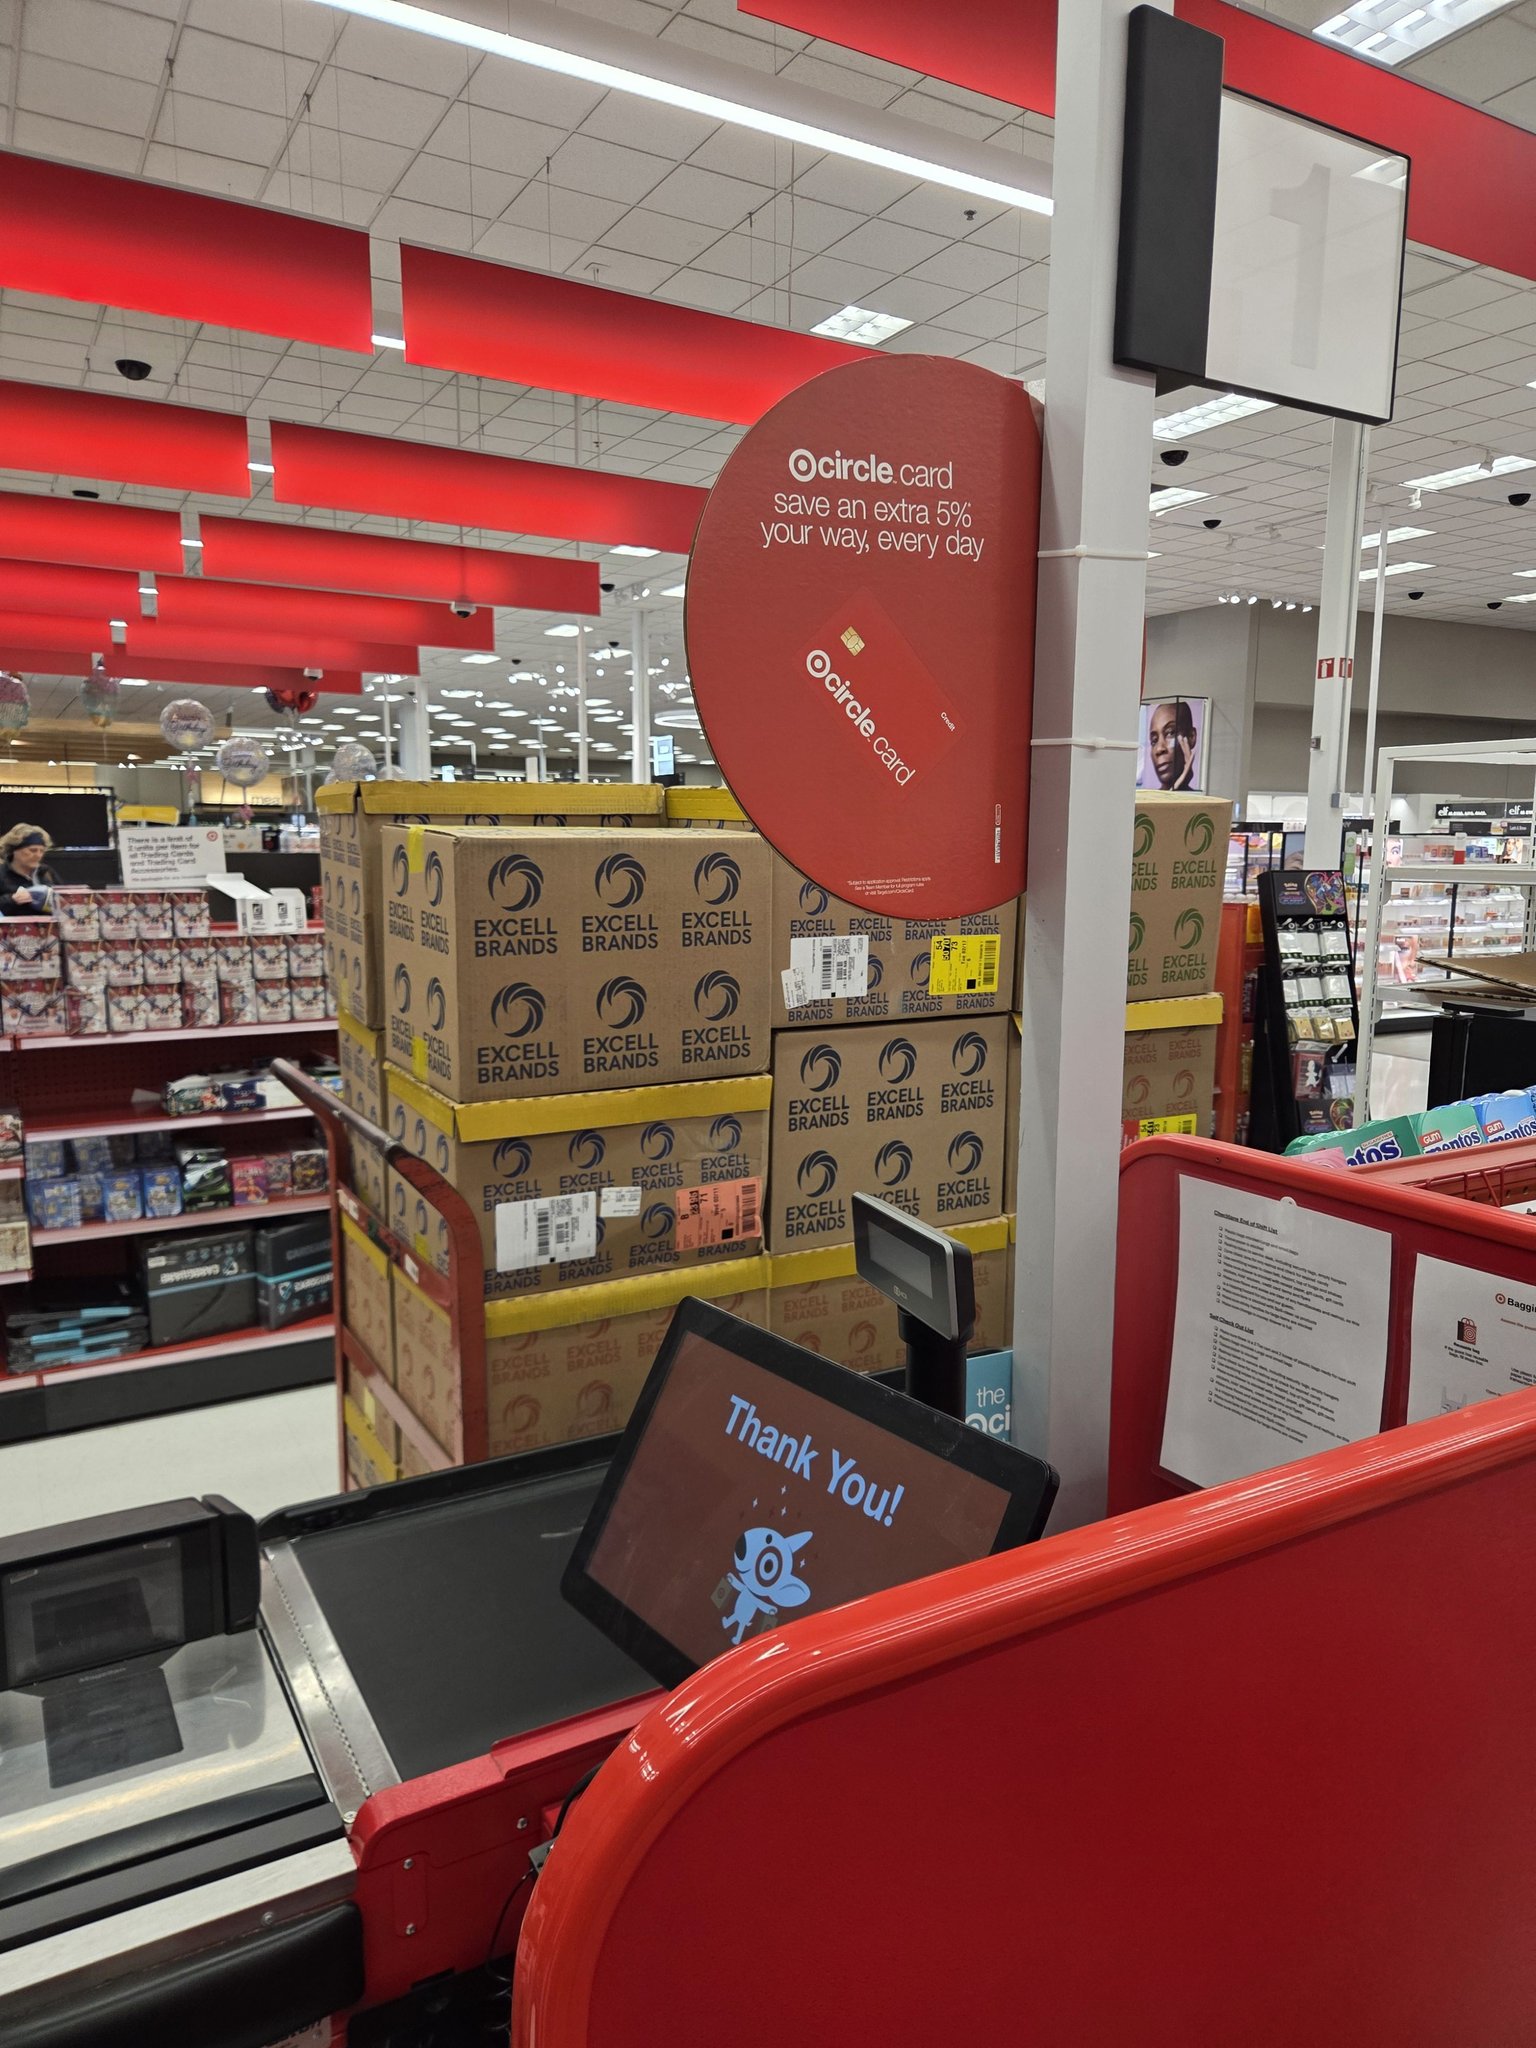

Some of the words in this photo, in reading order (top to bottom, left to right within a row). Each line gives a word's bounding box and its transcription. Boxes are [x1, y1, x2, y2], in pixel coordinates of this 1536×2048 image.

[818, 450, 893, 484] circle
[900, 461, 952, 490] card
[774, 493, 830, 517] save
[837, 498, 866, 520] an
[874, 498, 930, 524] extra
[760, 522, 813, 548] your
[820, 526, 870, 554] way,
[878, 530, 939, 559] every
[946, 530, 985, 562] day
[824, 672, 876, 738] circle
[873, 736, 916, 786] card
[140, 851, 169, 859] Trading
[1132, 862, 1158, 876] CELL
[1172, 860, 1217, 875] EXCELL
[1132, 876, 1157, 891] NDS
[1170, 874, 1216, 890] BRANDS
[389, 901, 414, 924] EXCELL
[682, 911, 752, 929] EXCELL
[961, 915, 999, 926] EXCELL
[389, 920, 415, 942] BRANDS
[421, 910, 449, 936] EXCELL
[474, 917, 558, 937] EXCELL
[582, 914, 658, 933] EXCELL
[790, 919, 836, 932] EXCELL
[849, 918, 892, 930] EXCELL
[421, 931, 450, 956] BRANDS
[475, 937, 558, 957] BRANDS
[582, 931, 658, 952] BRANDS
[682, 929, 752, 947] BRANDS
[1128, 958, 1149, 973] ELL
[1163, 954, 1207, 969] EXCELL
[1161, 967, 1206, 983] BRANDS
[847, 992, 889, 1005] EXCELL
[902, 1002, 943, 1013] BRANDS
[956, 998, 995, 1010] BRANDS
[788, 1009, 833, 1022] BRANDS
[847, 1005, 889, 1017] BRANDS
[392, 1033, 413, 1057] BRAND
[583, 1033, 659, 1055] EXCELL
[682, 1025, 751, 1046] EXCELL
[477, 1042, 560, 1064] EXCELL
[583, 1052, 659, 1073] BRANDS
[682, 1043, 751, 1064] BRANDS
[427, 1053, 452, 1081] RANDS
[478, 1061, 560, 1084] BRANDS
[867, 1087, 924, 1107] EXCELL
[941, 1079, 994, 1098] EXCELL
[788, 1095, 850, 1116] EXCELL
[867, 1103, 924, 1122] BRANDS
[941, 1095, 994, 1113] BRANDS
[788, 1112, 849, 1132] BRANDS
[1486, 1121, 1504, 1134] GUM
[1423, 1131, 1441, 1145] GUM
[632, 1162, 684, 1180] EXCELL
[701, 1153, 750, 1170] EXCELL
[560, 1171, 615, 1189] EXCELL
[701, 1166, 750, 1183] BRANDS
[483, 1179, 542, 1198] EXCELL
[938, 1177, 990, 1198] EXCELL
[785, 1199, 846, 1222] EXCELL
[937, 1192, 990, 1213] BRANDS
[785, 1215, 846, 1238] BRANDS
[1240, 1218, 1249, 1226] End
[1268, 1226, 1278, 1235] List
[630, 1240, 675, 1257] EXCEL
[698, 1241, 747, 1258] BRANDS
[629, 1251, 680, 1268] BRANDS
[559, 1263, 613, 1282] BRANDS
[484, 1275, 542, 1295] BRANDS
[841, 1286, 879, 1300] EXCEL
[784, 1294, 830, 1310] EXCELL
[841, 1296, 884, 1313] BRANDS
[784, 1307, 830, 1322] BRANDS
[567, 1339, 621, 1359] EXCELL
[492, 1352, 550, 1372] EXCELL
[567, 1353, 621, 1372] BRANDS
[492, 1365, 550, 1386] BRANDS
[976, 1386, 1005, 1407] the
[725, 1394, 819, 1481] Thank
[827, 1448, 905, 1527] You!
